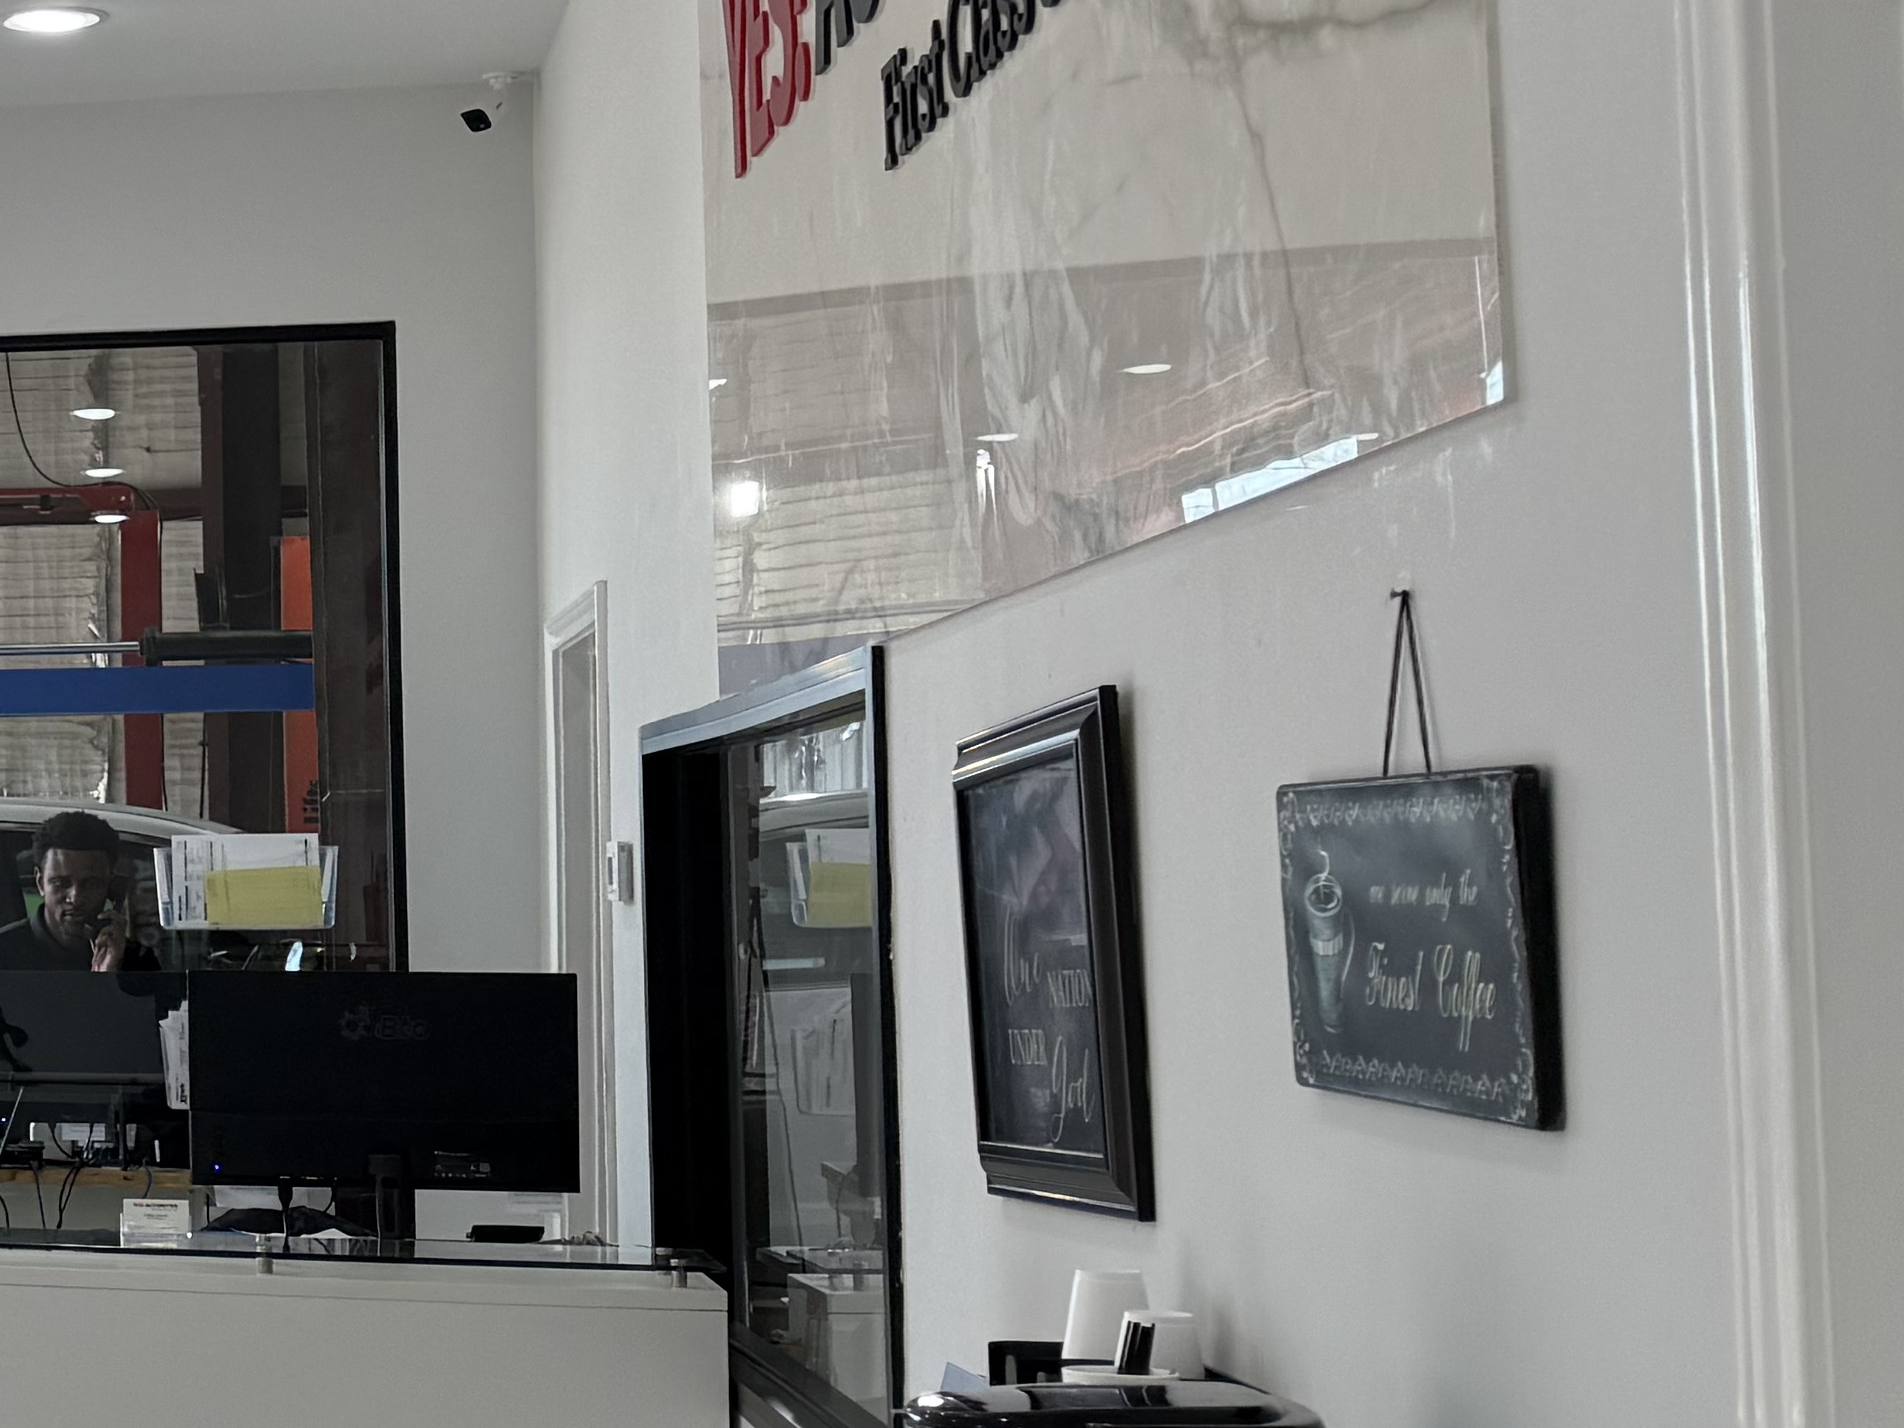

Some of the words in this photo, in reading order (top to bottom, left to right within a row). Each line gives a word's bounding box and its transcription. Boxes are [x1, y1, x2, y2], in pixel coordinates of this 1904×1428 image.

[880, 18, 949, 171] First
[1426, 872, 1452, 922] only
[1459, 869, 1479, 906] the
[1048, 968, 1093, 1007] NATION
[1366, 941, 1424, 1011] Finest
[1433, 944, 1497, 1052] Coffee
[1008, 1029, 1047, 1065] UNDER
